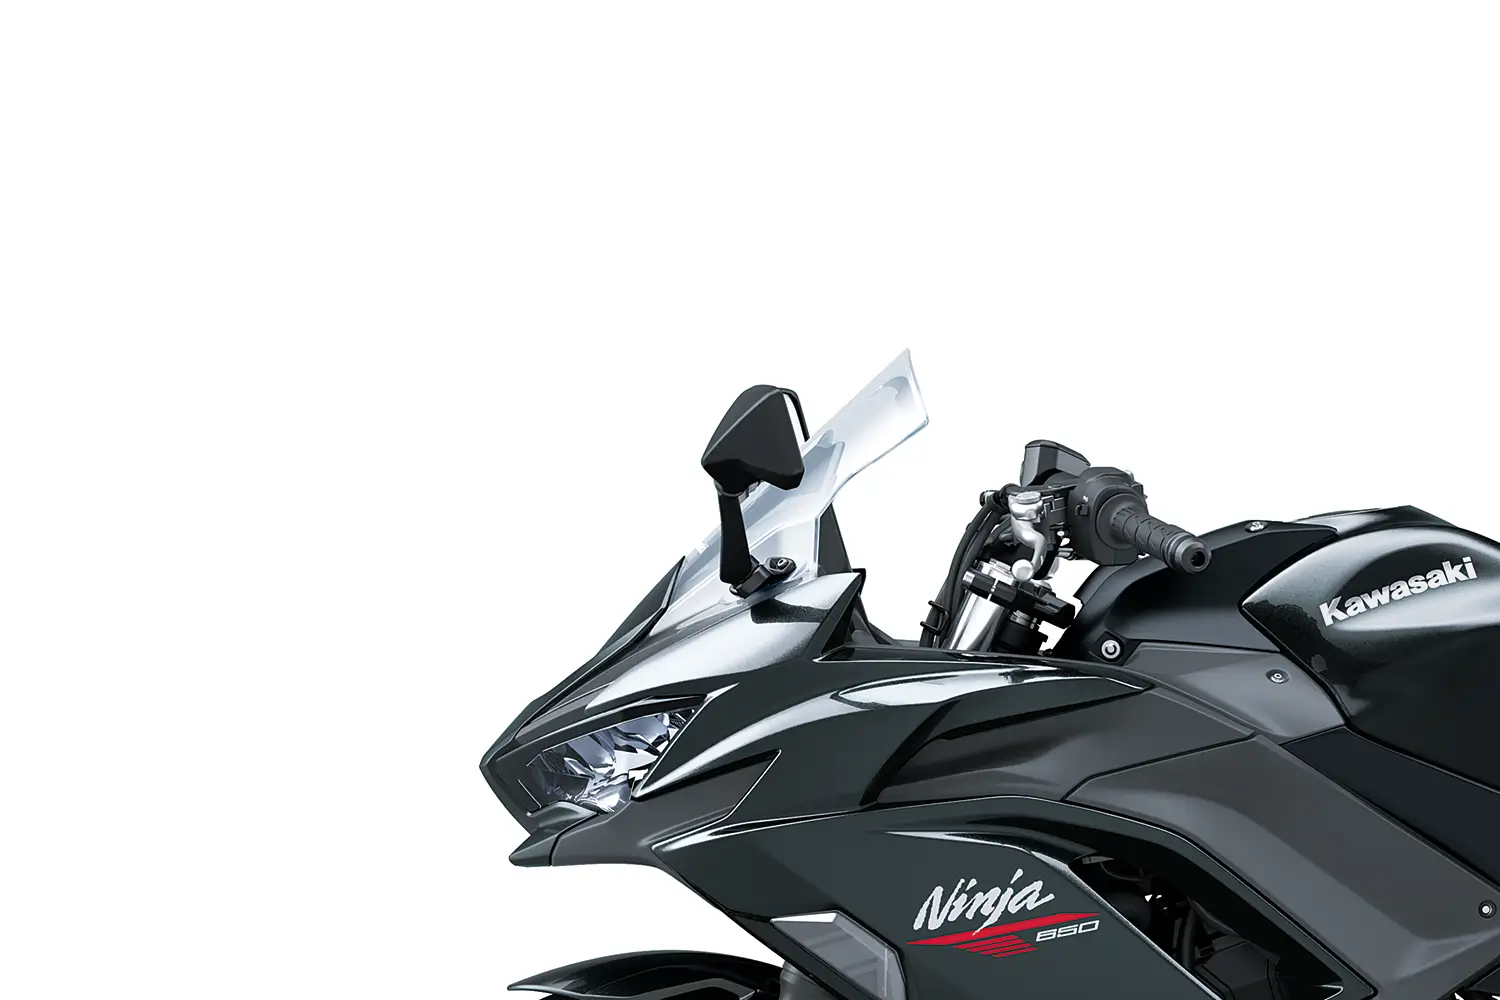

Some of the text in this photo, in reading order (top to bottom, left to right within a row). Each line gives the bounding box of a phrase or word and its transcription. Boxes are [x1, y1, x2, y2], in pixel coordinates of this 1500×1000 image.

[1318, 556, 1478, 627] Kawasaki
[913, 868, 1055, 936] Ninja
[1035, 919, 1100, 942] 650
